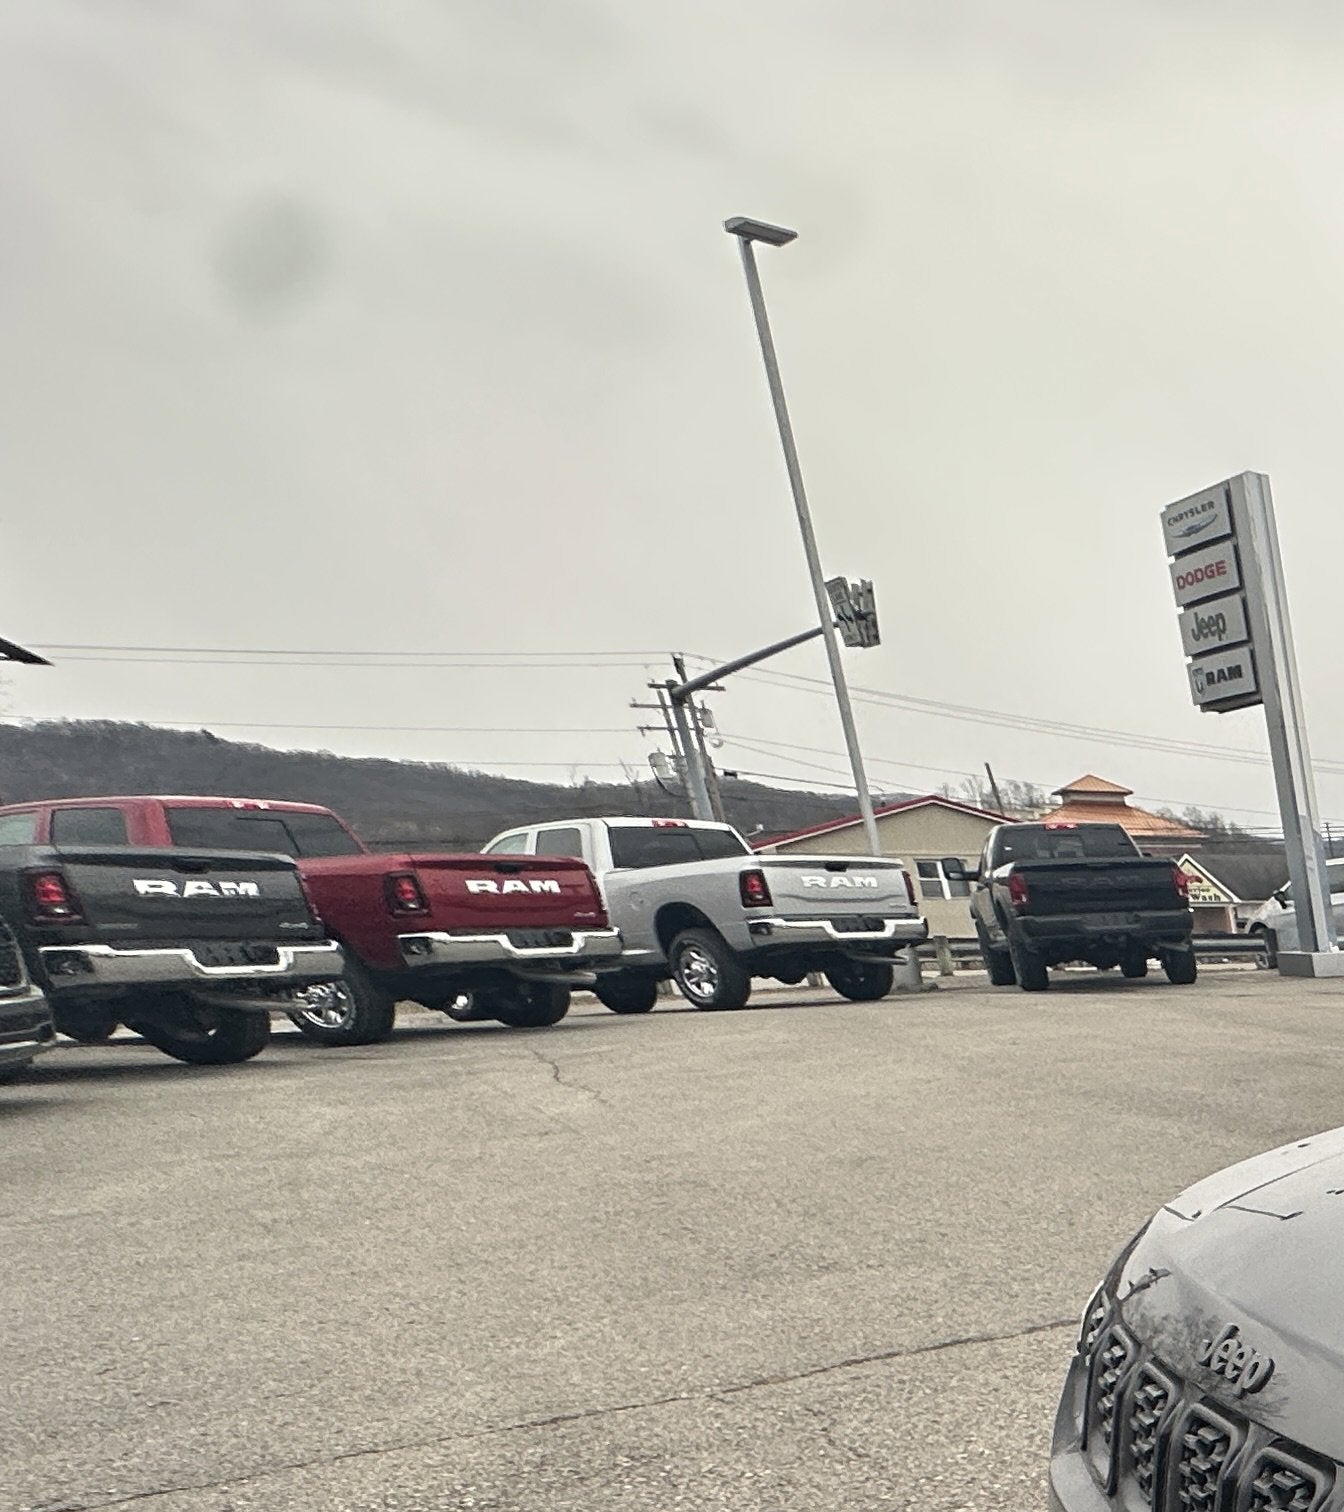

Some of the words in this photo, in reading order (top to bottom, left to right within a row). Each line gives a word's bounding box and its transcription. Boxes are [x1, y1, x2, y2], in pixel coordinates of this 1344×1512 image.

[1166, 500, 1215, 527] CHRYSLER
[1176, 560, 1227, 590] DODGE
[1191, 611, 1226, 642] Jeep
[1205, 664, 1243, 687] RAM
[132, 879, 261, 898] RAM
[464, 879, 561, 894] RAM
[801, 875, 878, 888] RAM
[1197, 1322, 1275, 1399] Jeep
